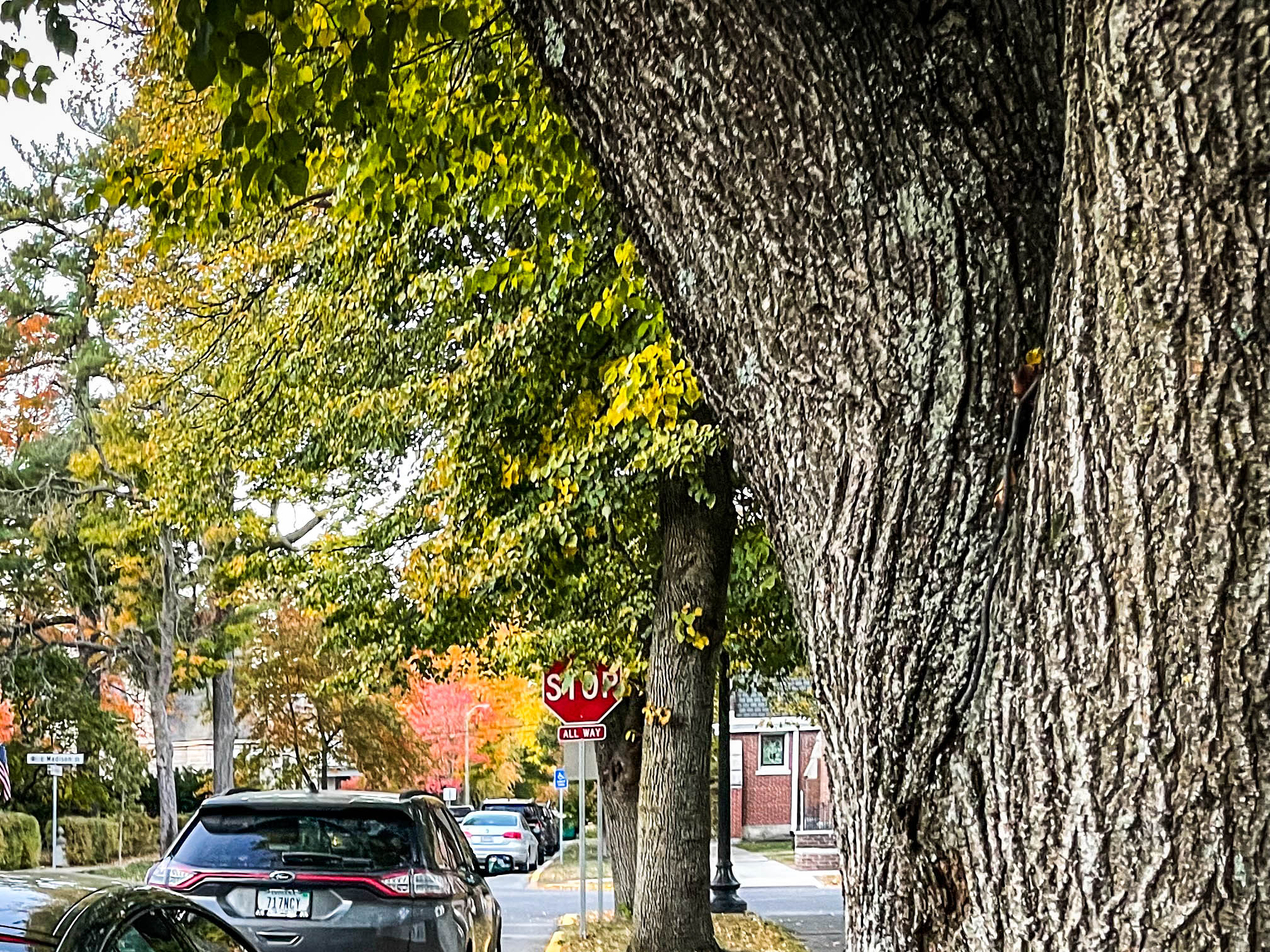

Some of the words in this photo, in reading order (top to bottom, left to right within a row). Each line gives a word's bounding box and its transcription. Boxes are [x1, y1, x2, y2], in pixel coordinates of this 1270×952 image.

[545, 671, 619, 701] STOP
[563, 729, 579, 739] ALL
[582, 728, 601, 738] WAY
